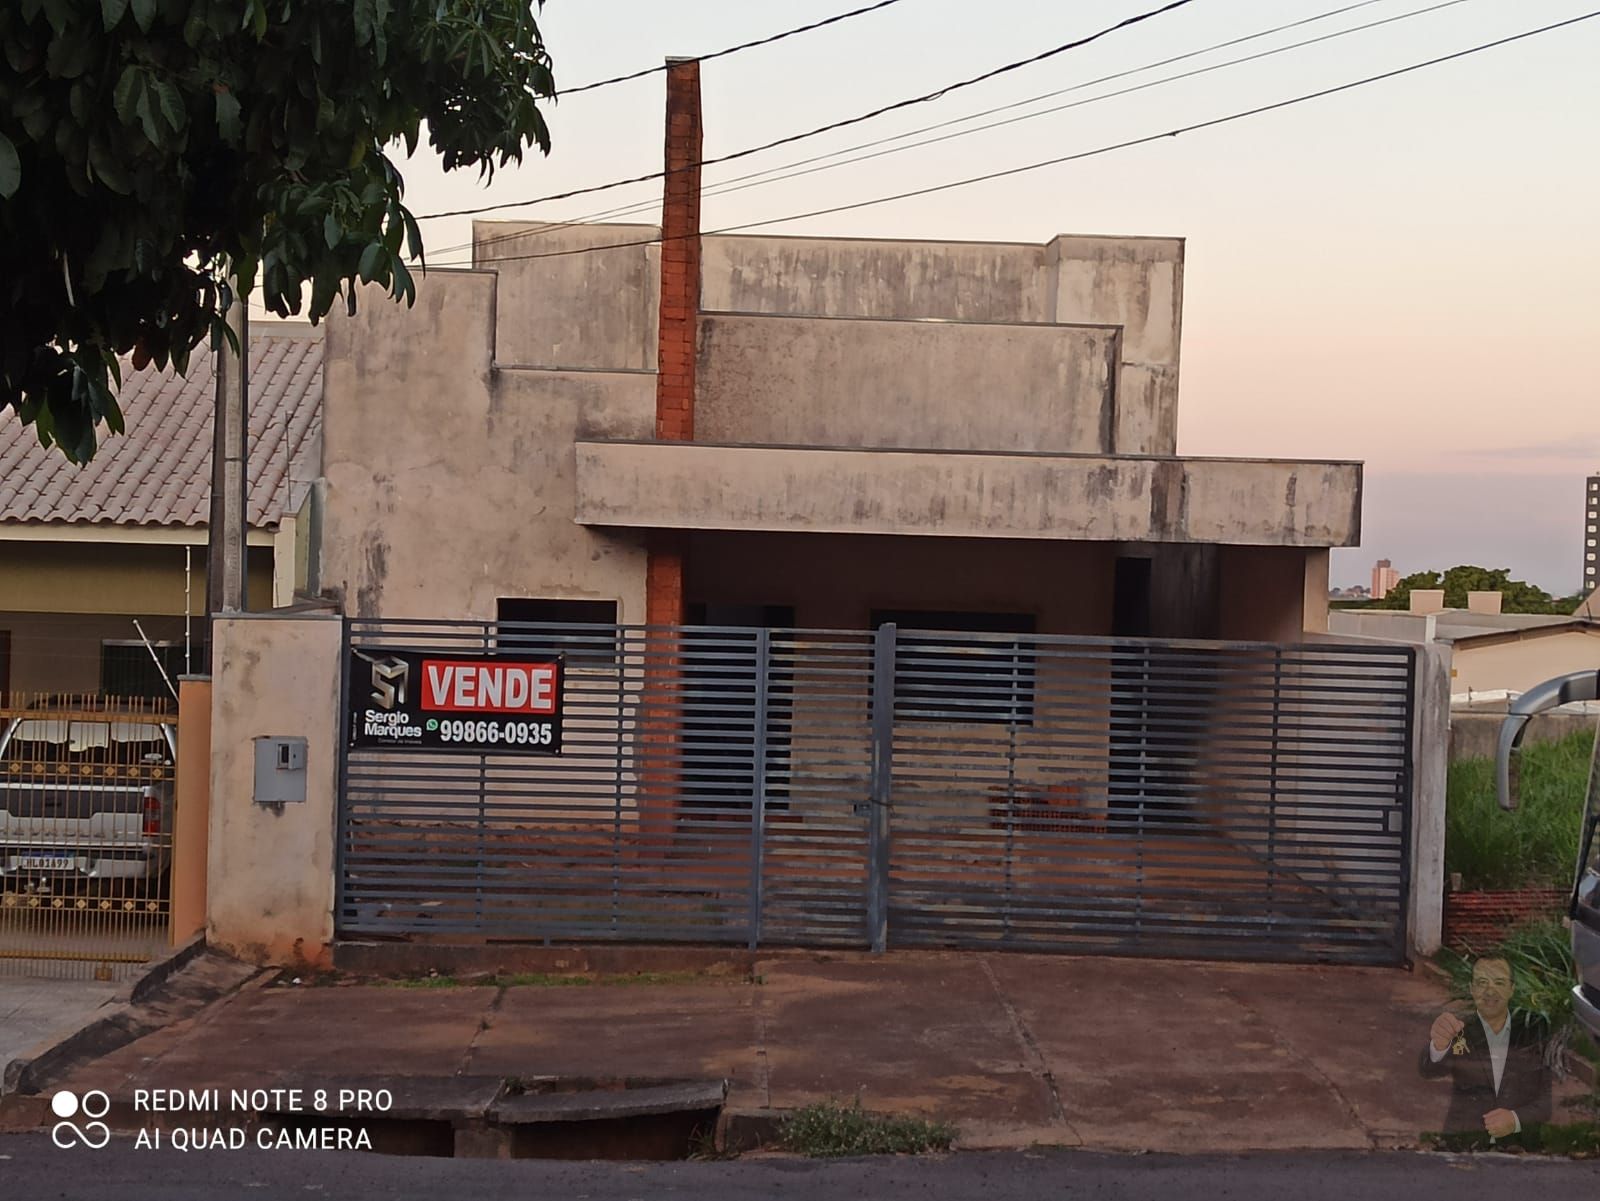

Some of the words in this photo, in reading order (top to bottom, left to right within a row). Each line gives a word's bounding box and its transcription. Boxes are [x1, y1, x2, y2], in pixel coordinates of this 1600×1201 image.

[427, 665, 553, 709] VENDE
[364, 709, 409, 725] Sergio
[364, 722, 422, 739] Marques
[440, 720, 552, 744] 99866-0935
